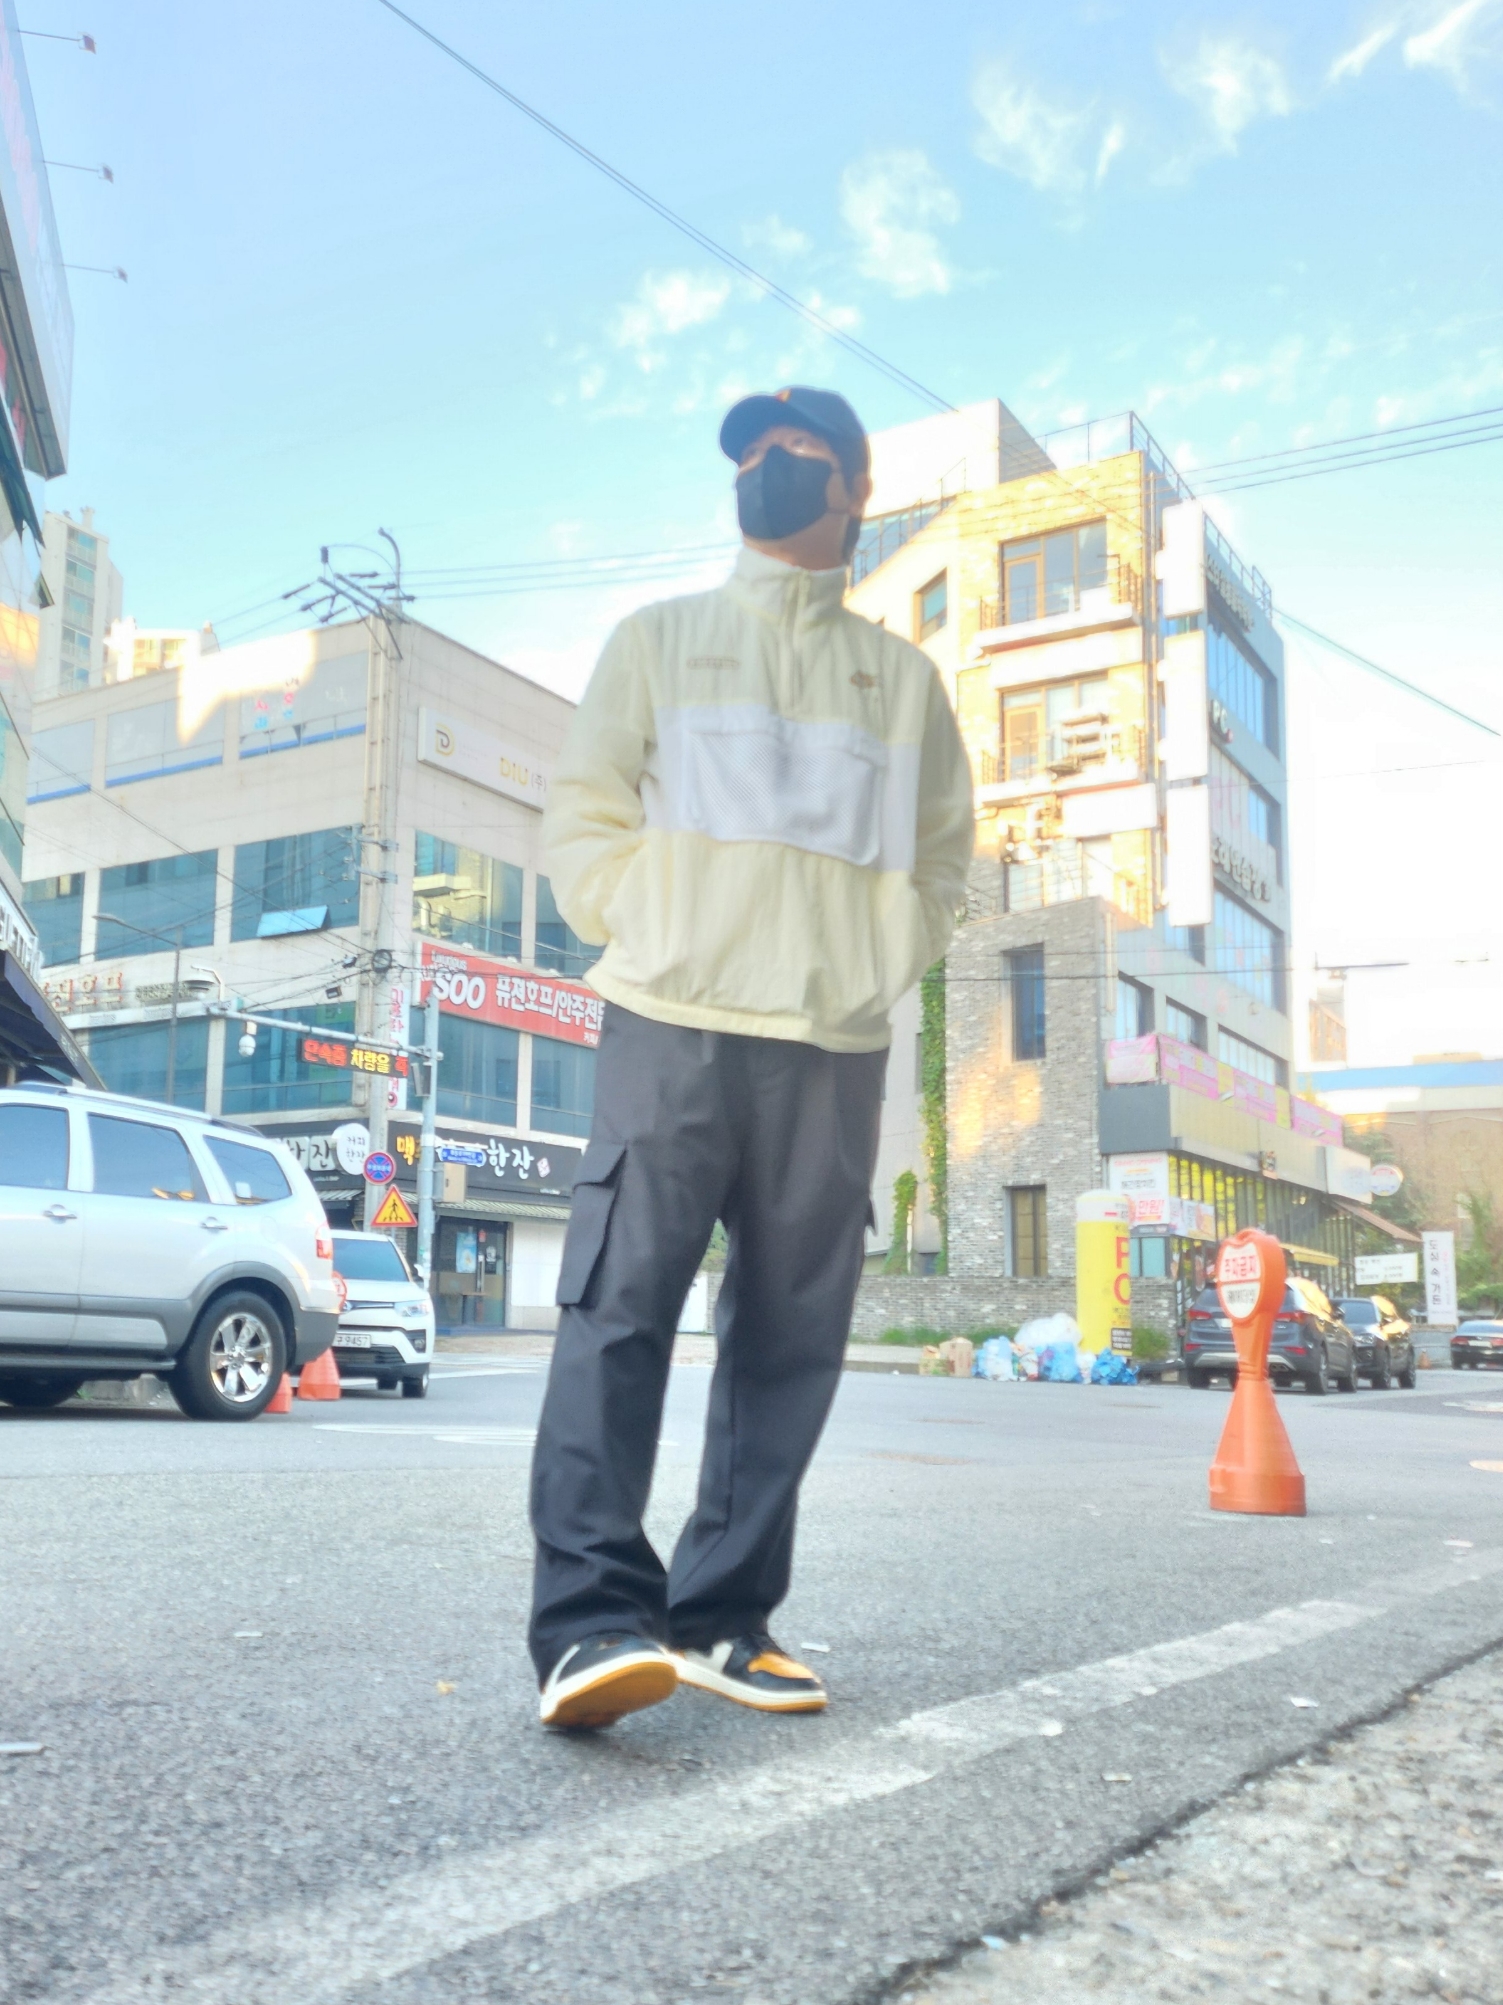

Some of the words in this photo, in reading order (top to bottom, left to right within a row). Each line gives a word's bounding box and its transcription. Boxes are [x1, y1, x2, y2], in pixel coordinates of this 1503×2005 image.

[432, 969, 486, 1010] SOO
[350, 1048, 390, 1074] 차량을
[396, 1135, 420, 1166] 맥
[487, 1138, 535, 1180] 한잔
